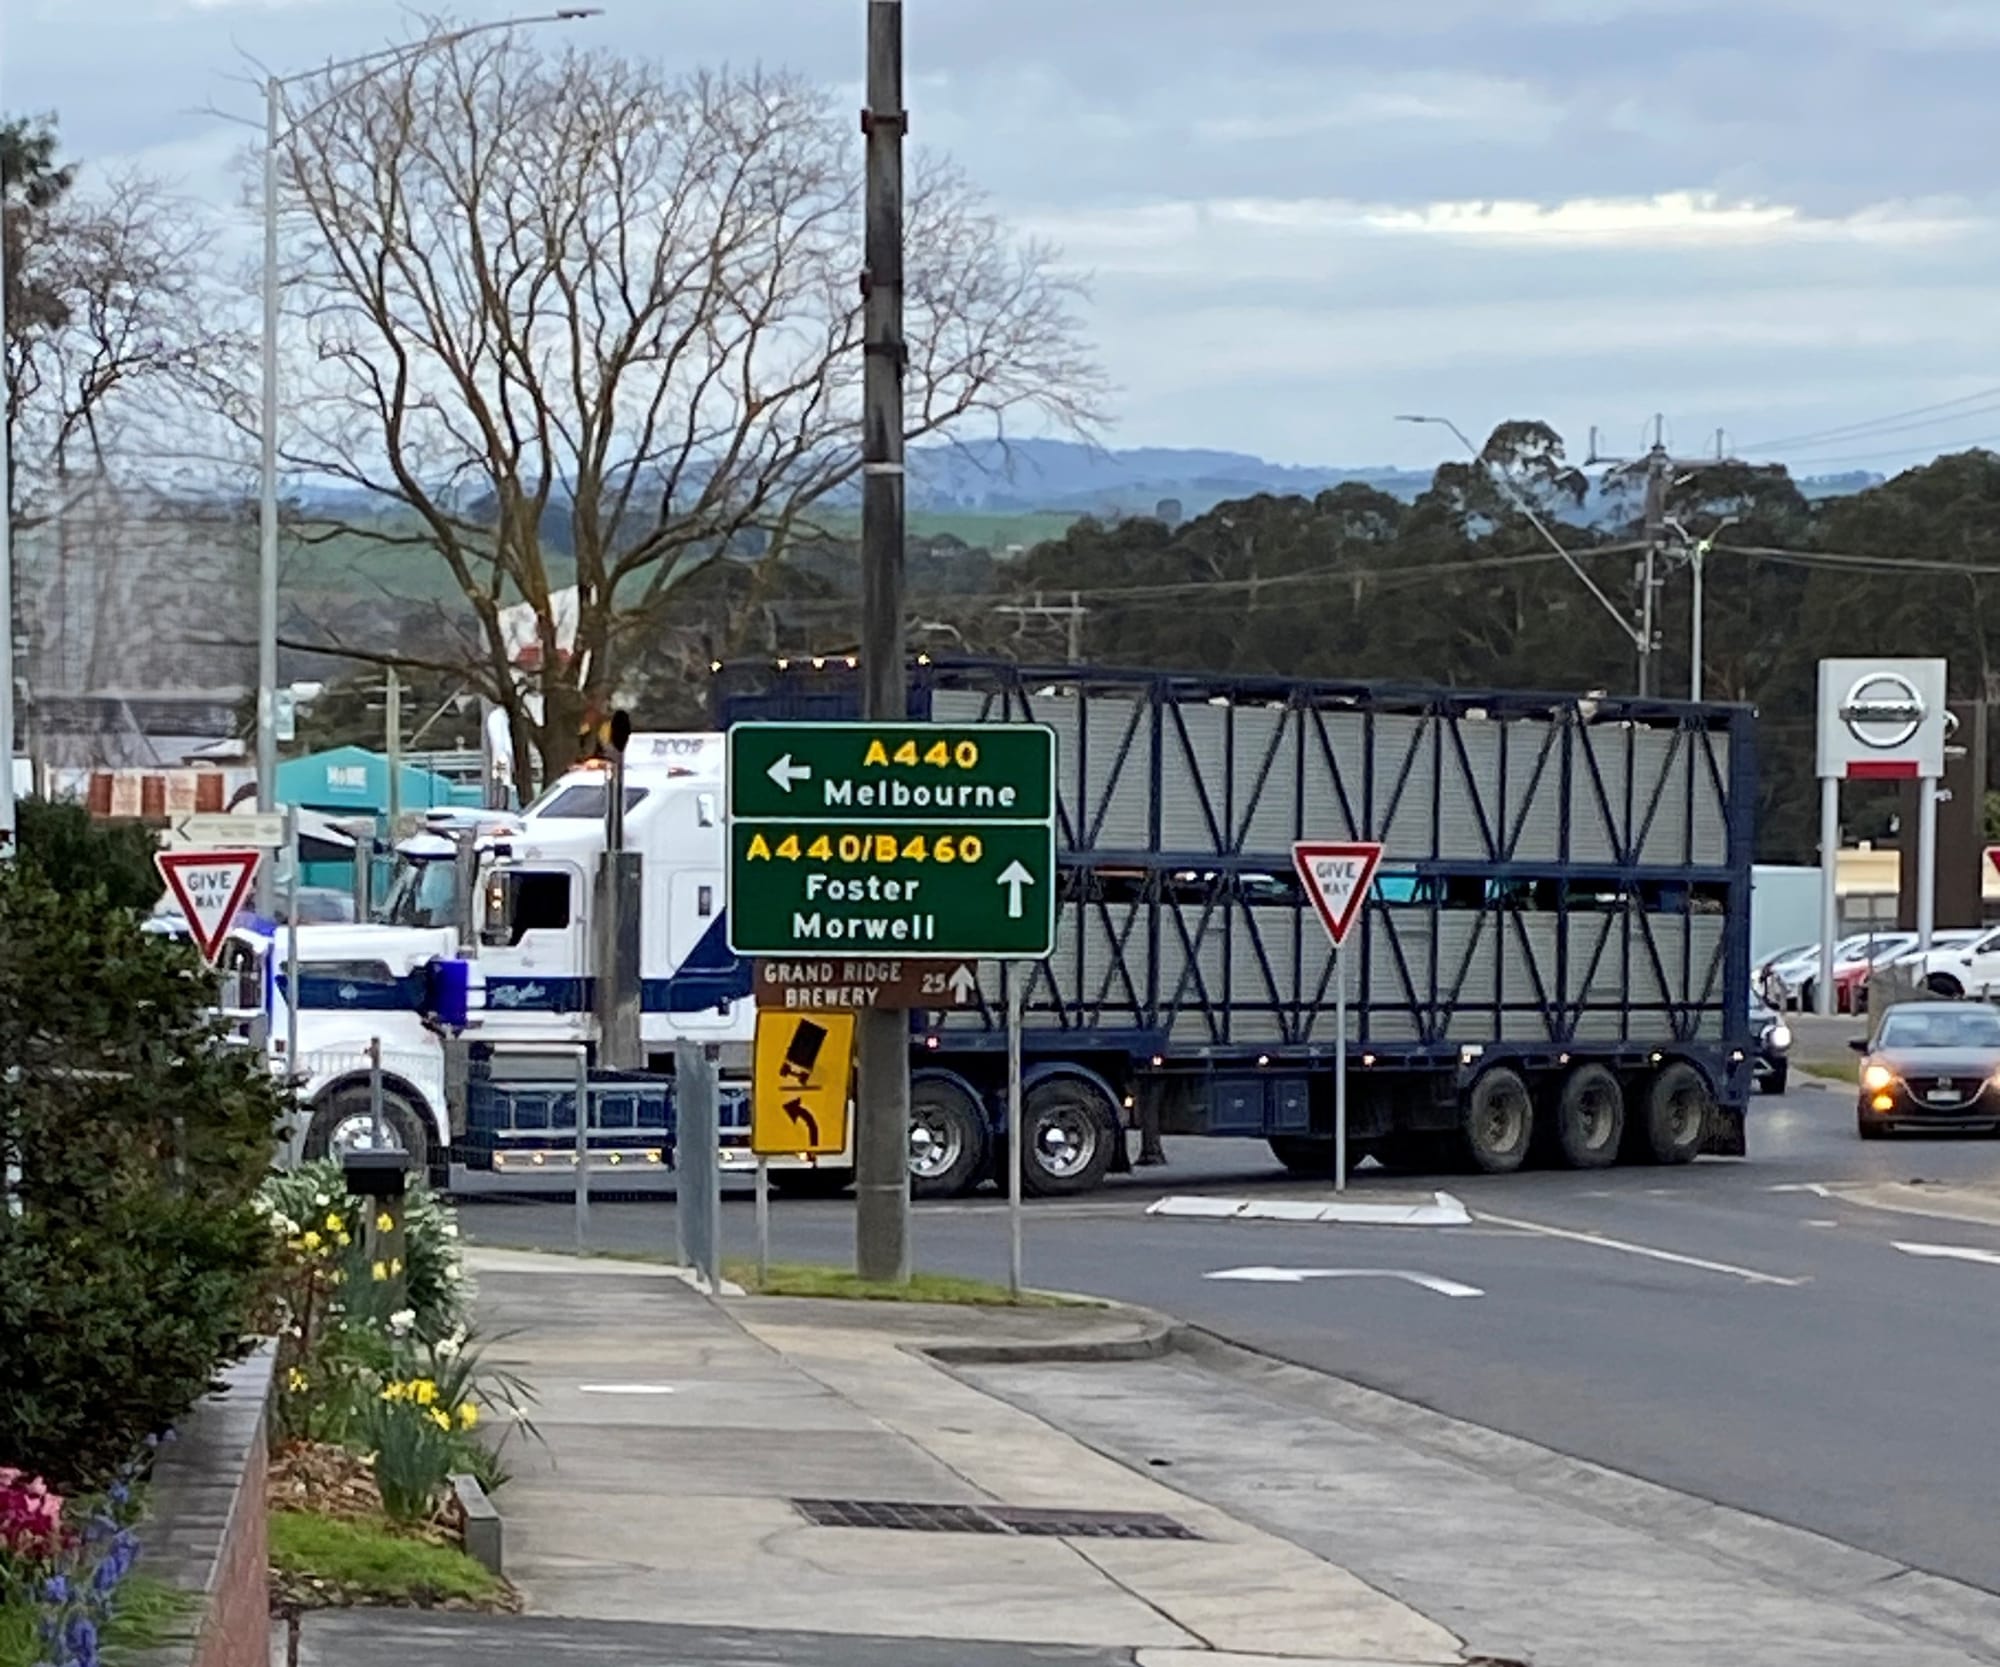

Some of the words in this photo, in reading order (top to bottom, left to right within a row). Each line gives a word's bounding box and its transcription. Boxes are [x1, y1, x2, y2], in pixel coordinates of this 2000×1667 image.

[863, 739, 978, 769] A440
[823, 779, 1016, 807] Melbourne
[746, 834, 983, 863] A440/B460
[187, 871, 232, 891] GIVE
[1316, 862, 1357, 878] GIVE
[806, 874, 919, 901] Foster
[793, 913, 935, 940] Morwell
[764, 962, 833, 983] GRAND
[843, 962, 902, 982] RIDGE
[920, 973, 946, 993] 25
[785, 987, 879, 1009] BREWERY
